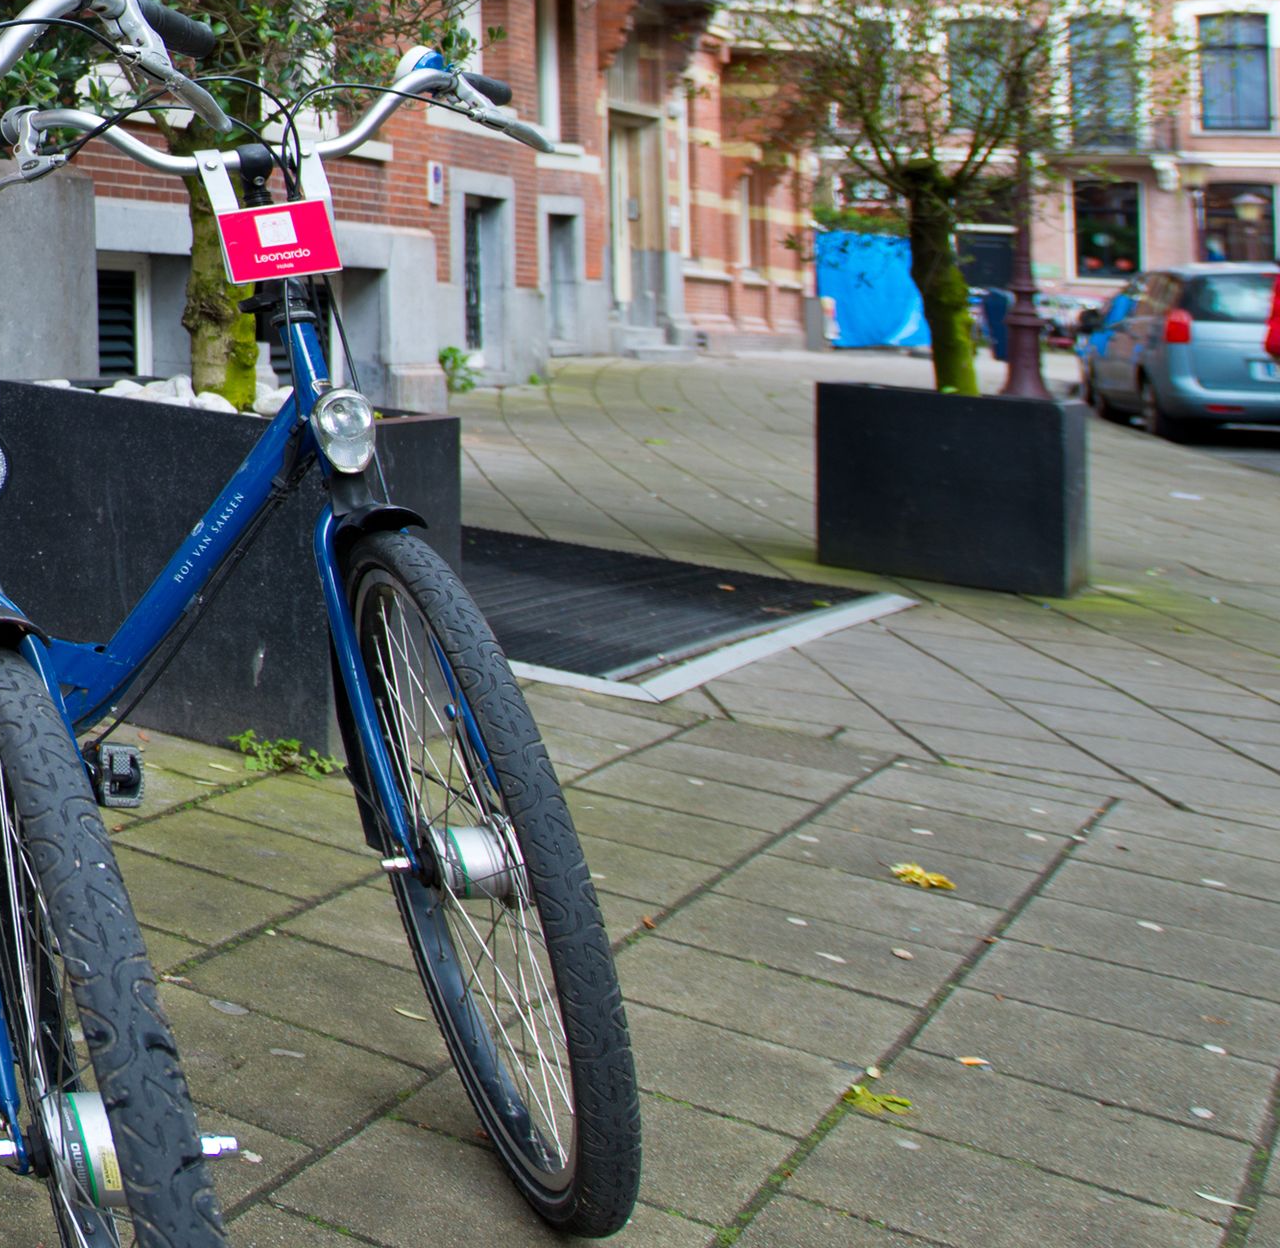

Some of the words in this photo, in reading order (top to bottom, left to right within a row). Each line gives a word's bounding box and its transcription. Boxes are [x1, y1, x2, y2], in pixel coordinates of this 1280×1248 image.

[254, 247, 311, 264] Leonardo
[173, 559, 194, 583] HOF
[192, 535, 213, 558] VAN
[211, 492, 245, 533] SAKSEN
